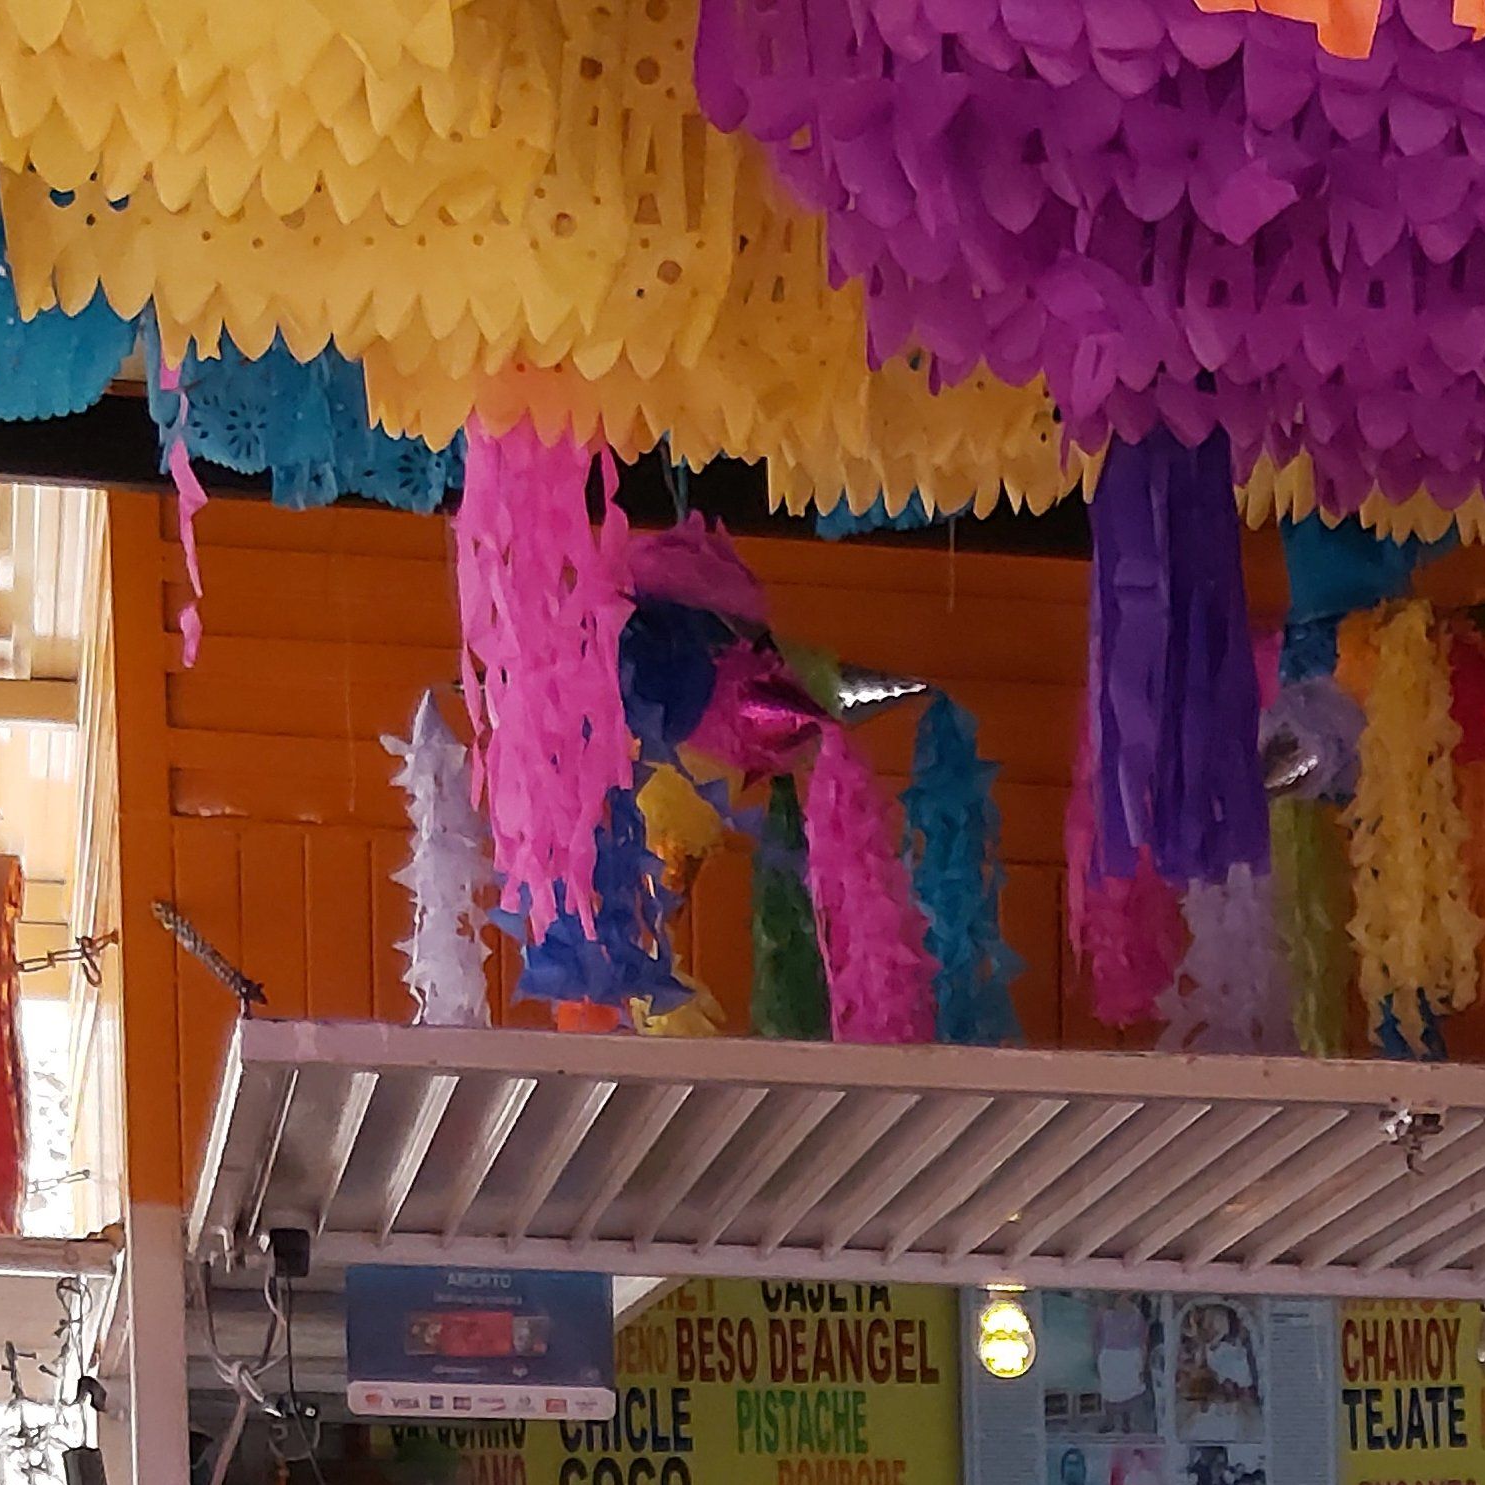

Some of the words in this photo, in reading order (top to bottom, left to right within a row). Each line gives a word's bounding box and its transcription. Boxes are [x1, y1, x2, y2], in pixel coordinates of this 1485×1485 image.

[676, 1317, 758, 1382] BESO
[769, 1318, 808, 1383] DE
[812, 1318, 939, 1384] ANGEL
[1342, 1318, 1461, 1382] CHAMOY
[560, 1388, 693, 1452] CHICLE
[736, 1389, 870, 1454] PISTACHE
[1342, 1387, 1468, 1450] TEJATE
